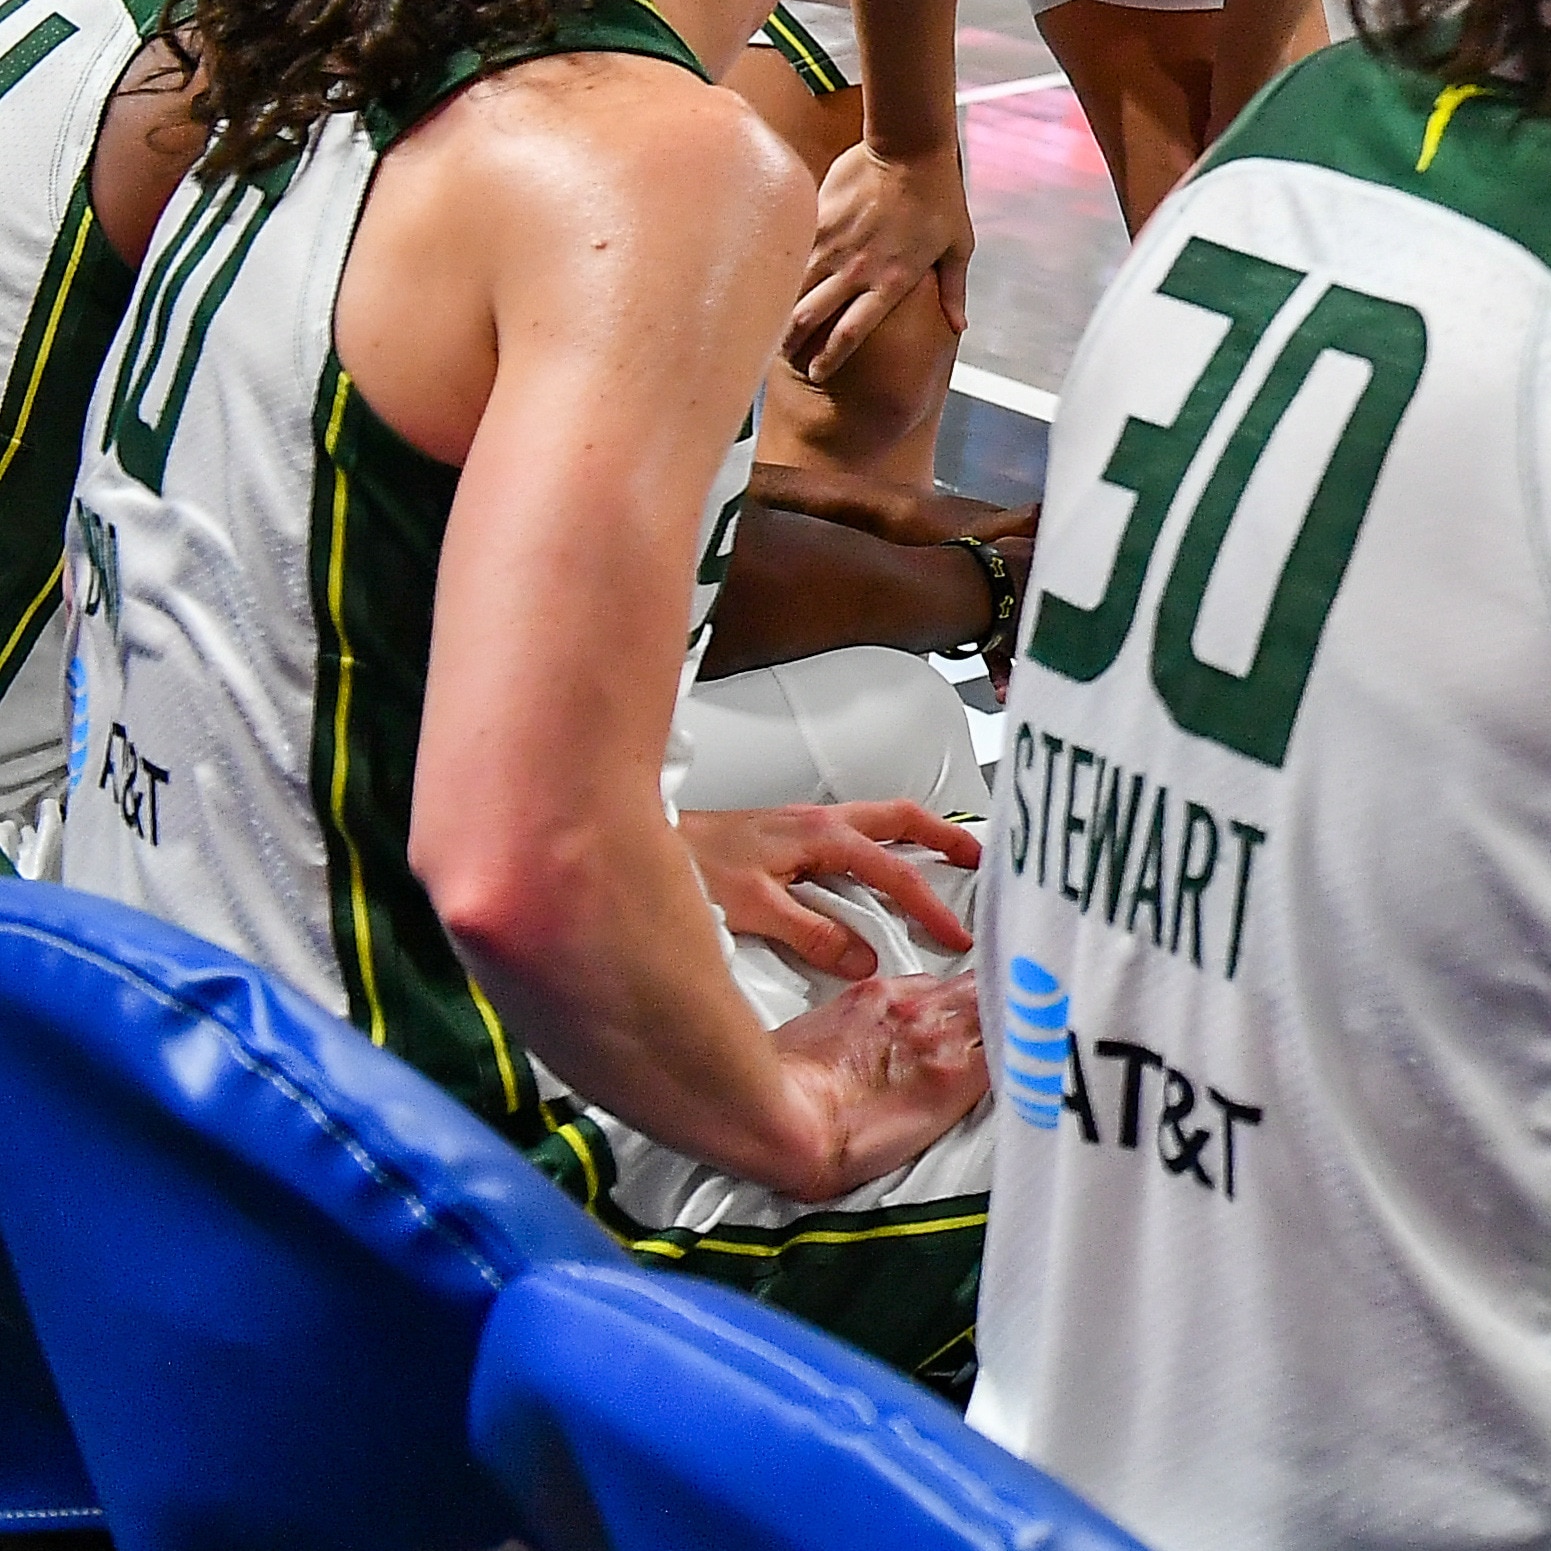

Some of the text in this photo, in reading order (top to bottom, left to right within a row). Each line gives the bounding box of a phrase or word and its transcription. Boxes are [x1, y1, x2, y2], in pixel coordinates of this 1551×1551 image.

[1026, 234, 1429, 770] 30
[1009, 720, 1267, 981] STEWART
[1058, 1028, 1263, 1202] AT&T
